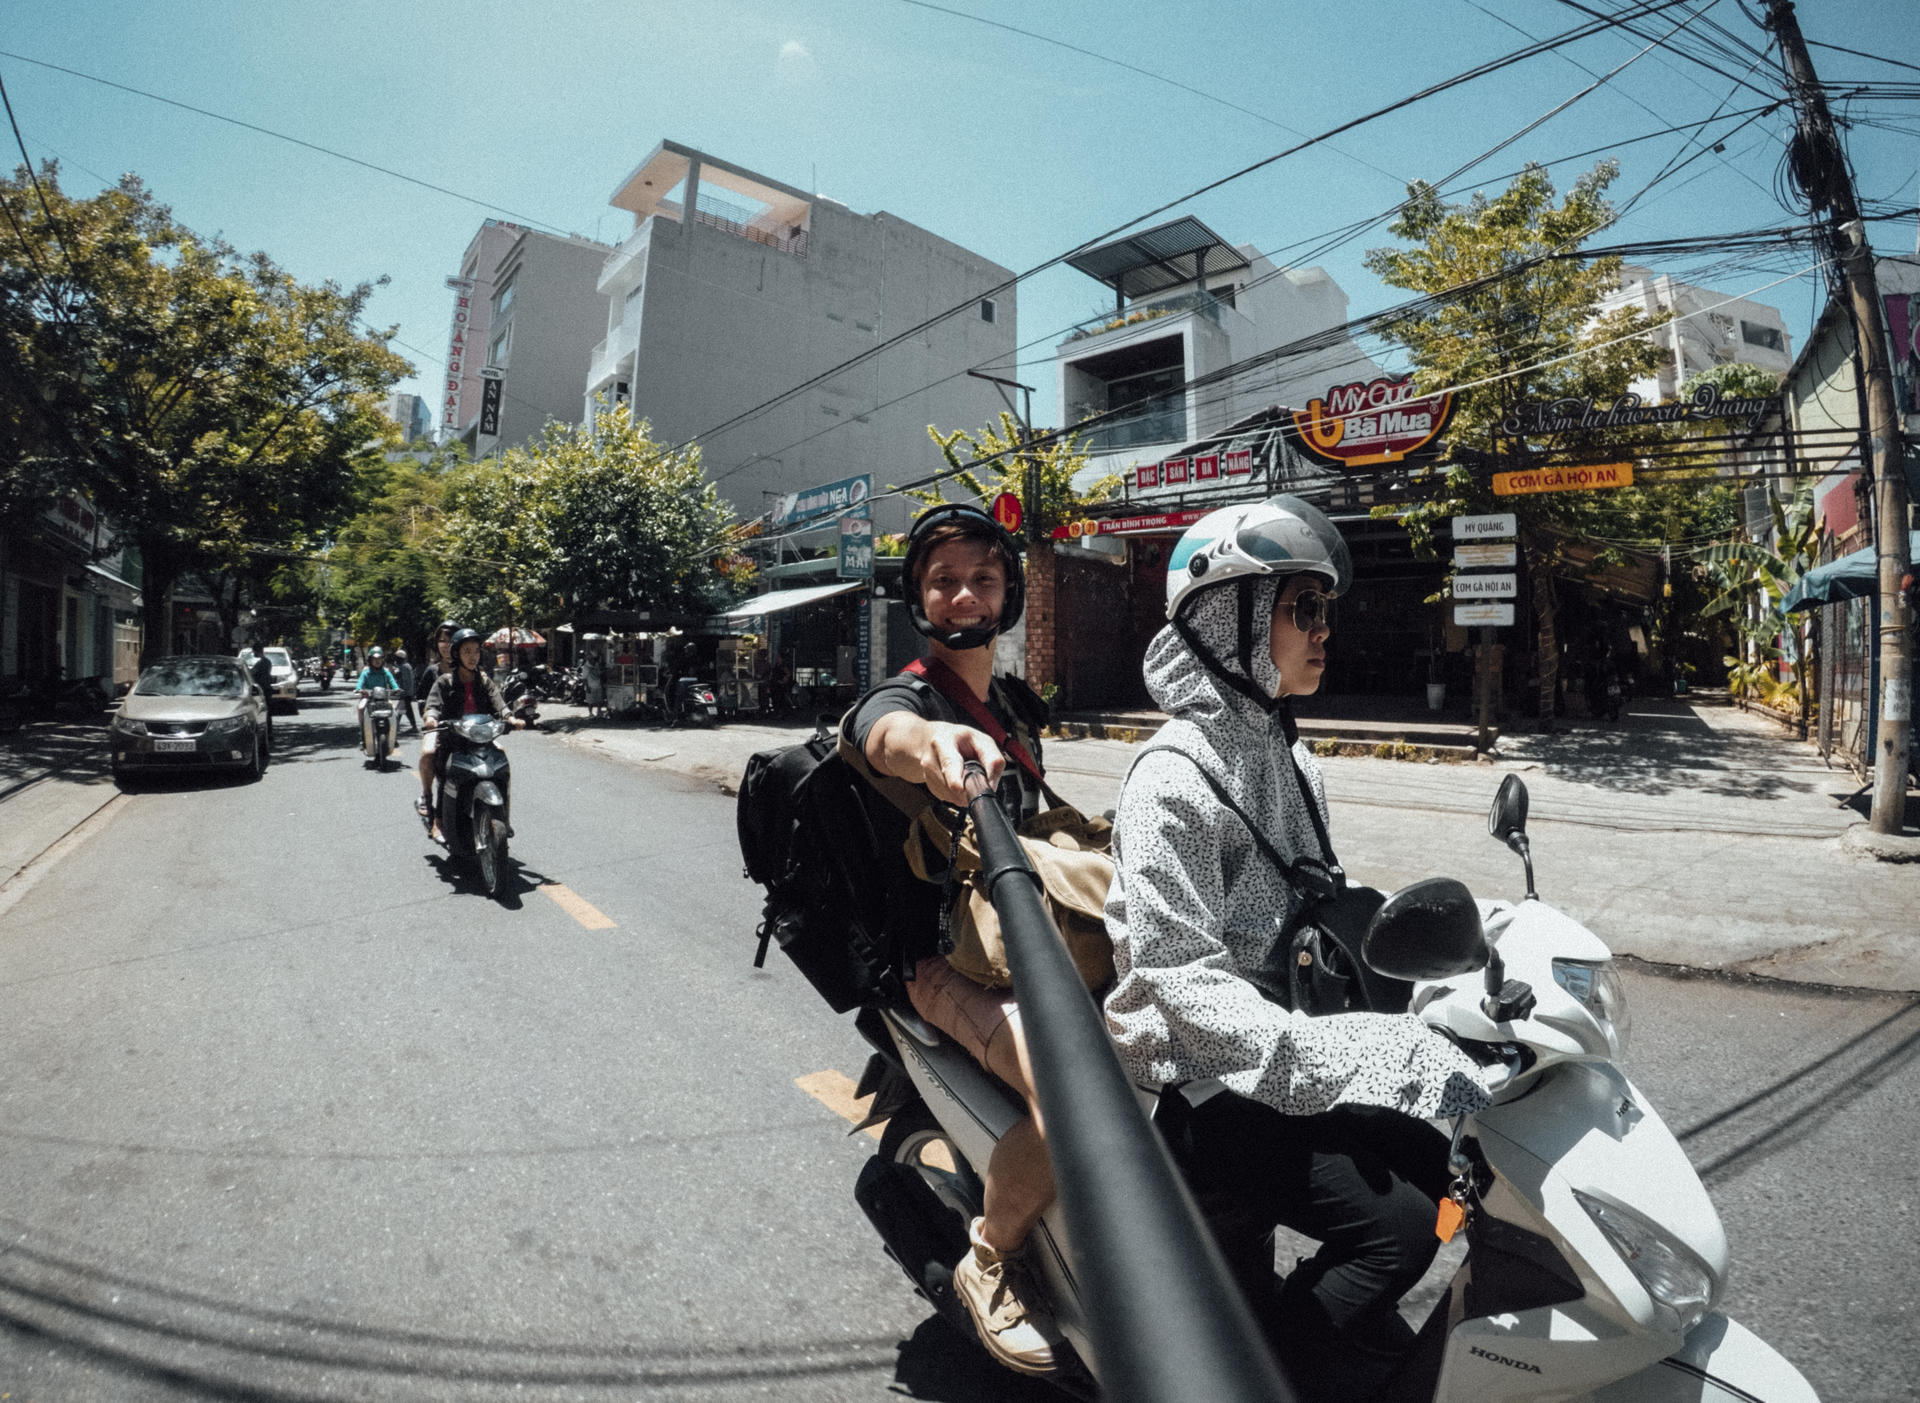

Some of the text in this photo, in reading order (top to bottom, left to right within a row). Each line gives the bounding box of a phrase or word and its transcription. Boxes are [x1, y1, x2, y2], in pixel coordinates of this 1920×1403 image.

[1379, 410, 1432, 434] Mua
[1596, 469, 1617, 483] AN
[1501, 581, 1512, 592] AN
[1469, 1345, 1542, 1374] HONDA
